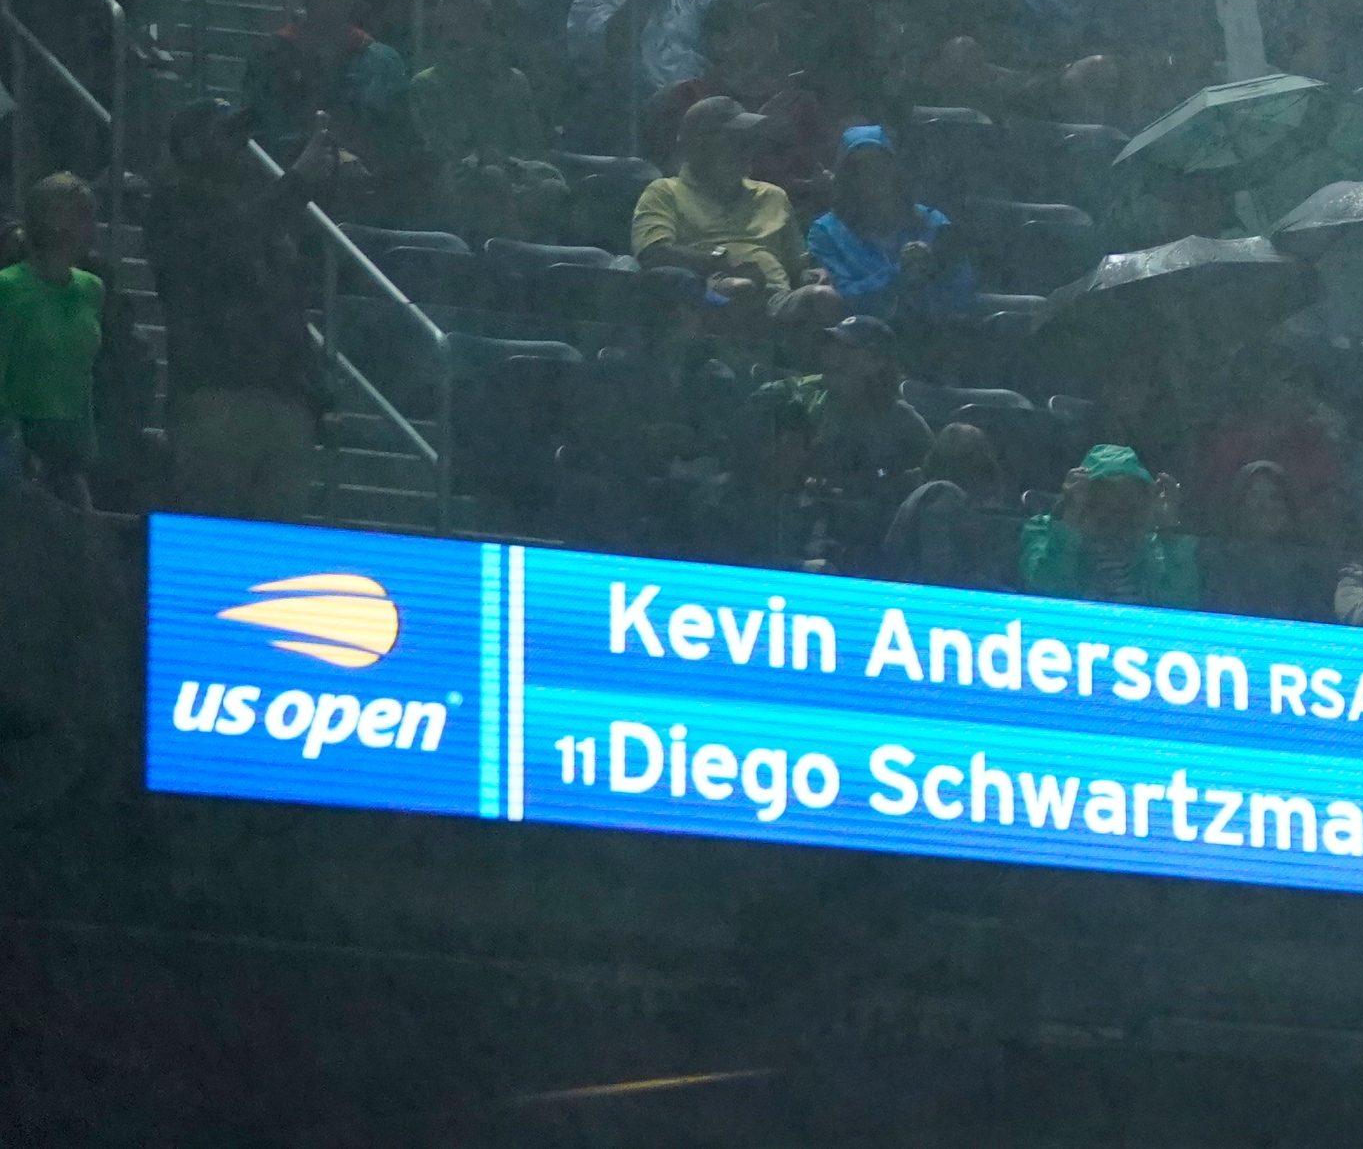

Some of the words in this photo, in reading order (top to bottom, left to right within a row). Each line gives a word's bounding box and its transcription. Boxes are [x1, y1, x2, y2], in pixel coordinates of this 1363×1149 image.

[611, 583, 837, 673] Kevin
[866, 609, 1249, 710] Anderson
[265, 691, 447, 758] open
[556, 736, 596, 785] 11
[611, 721, 840, 822] Diego
